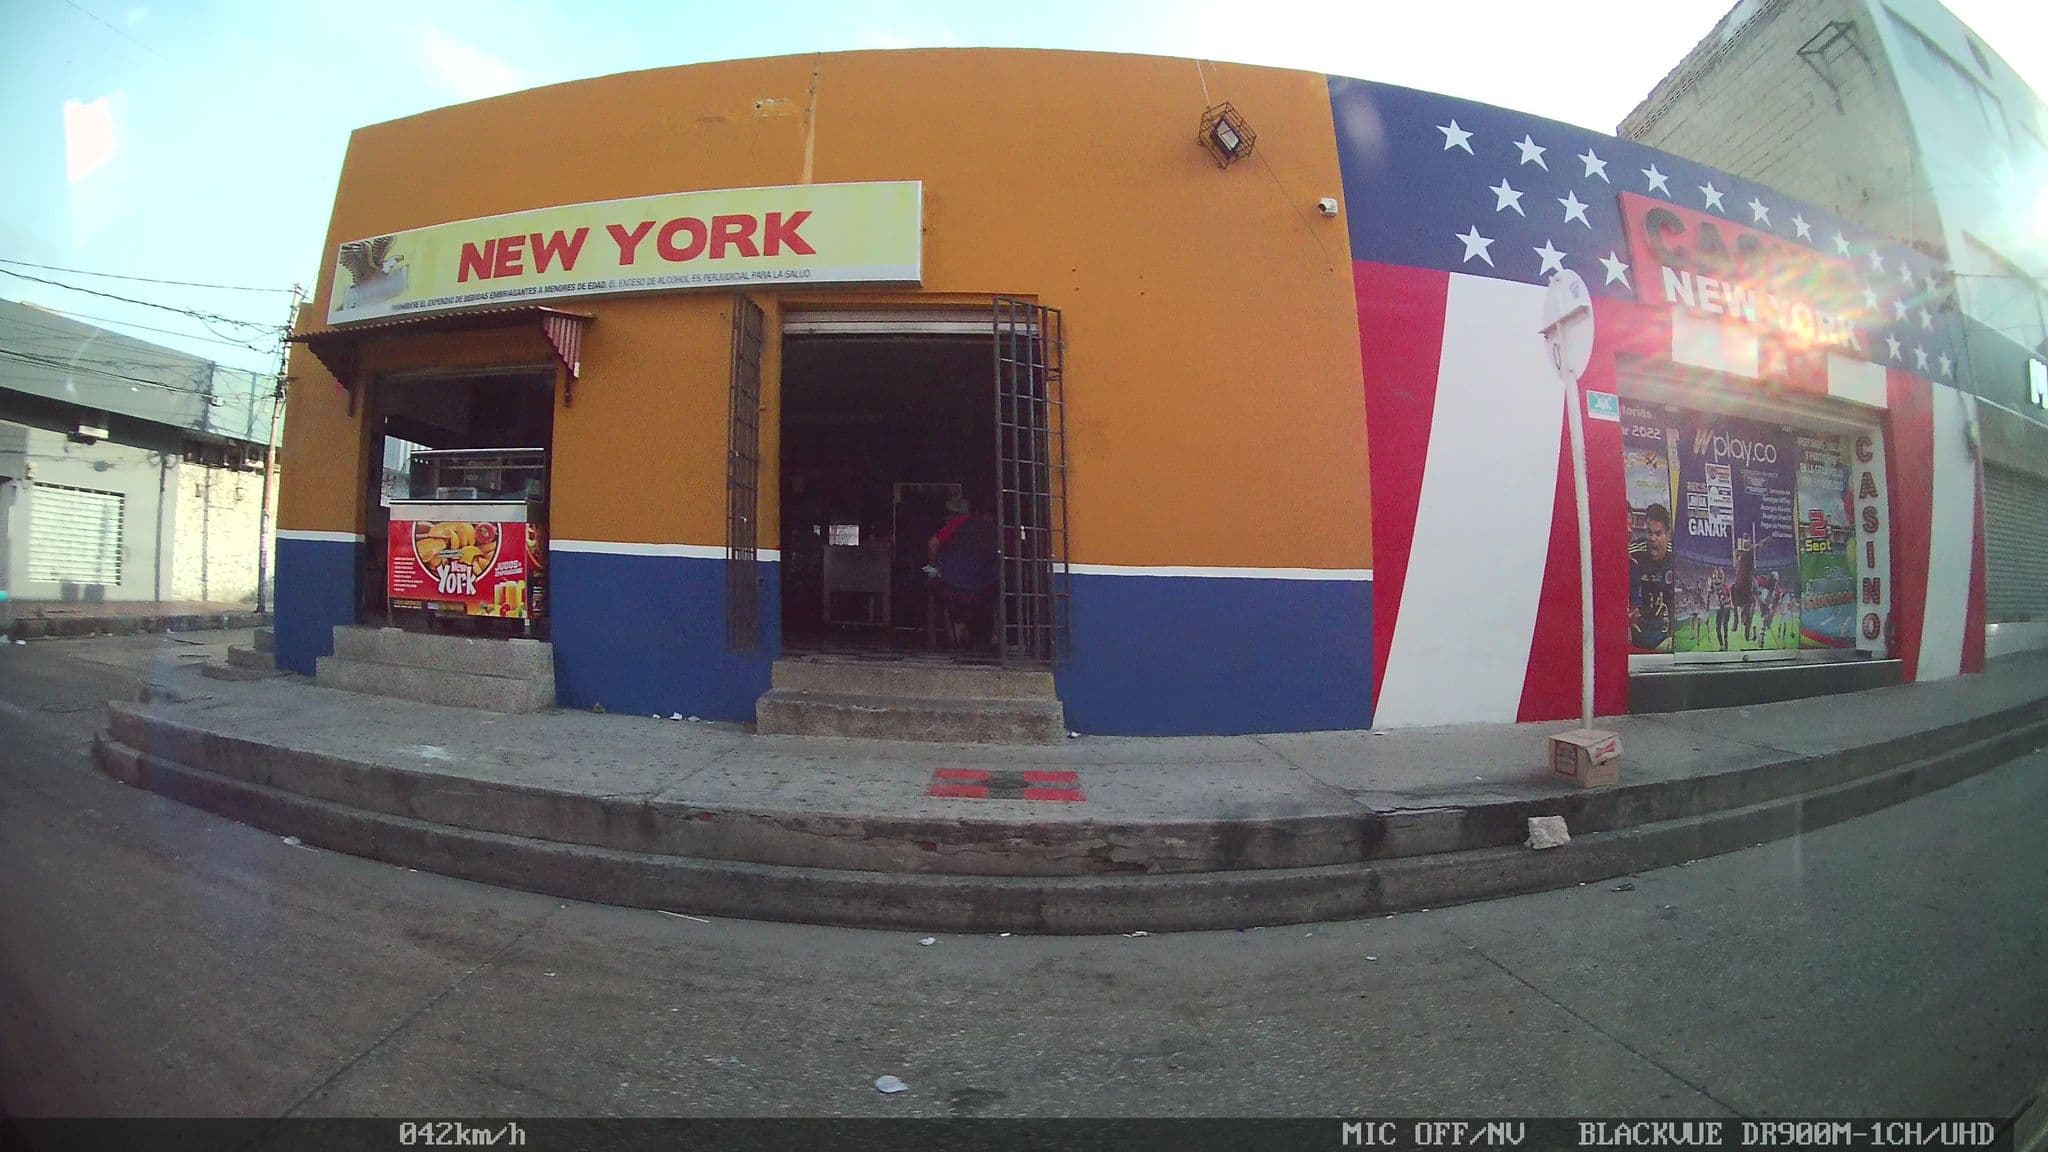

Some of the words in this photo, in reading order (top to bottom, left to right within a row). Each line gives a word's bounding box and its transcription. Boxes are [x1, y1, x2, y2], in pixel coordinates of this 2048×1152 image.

[458, 227, 590, 283] NEW
[606, 211, 817, 266] YORK
[538, 285, 544, 295] A
[544, 283, 577, 294] MENORES
[577, 282, 587, 291] DE
[609, 279, 617, 288] EL
[618, 277, 645, 287] EXCESO
[646, 276, 656, 286] DE
[657, 274, 692, 285] ALCOHOL
[692, 273, 702, 283] ES
[703, 271, 750, 282] PERJUDICIAL
[751, 270, 773, 280] PARA
[773, 269, 784, 279] LA
[1661, 265, 1757, 322] NEW
[1767, 294, 1863, 352] YORK
[1632, 424, 1662, 441] 2022
[1688, 518, 1728, 538] GANAR
[1855, 435, 1882, 641] CASINO
[1805, 539, 1832, 553] Sept
[451, 560, 468, 572] New
[436, 563, 477, 596] York
